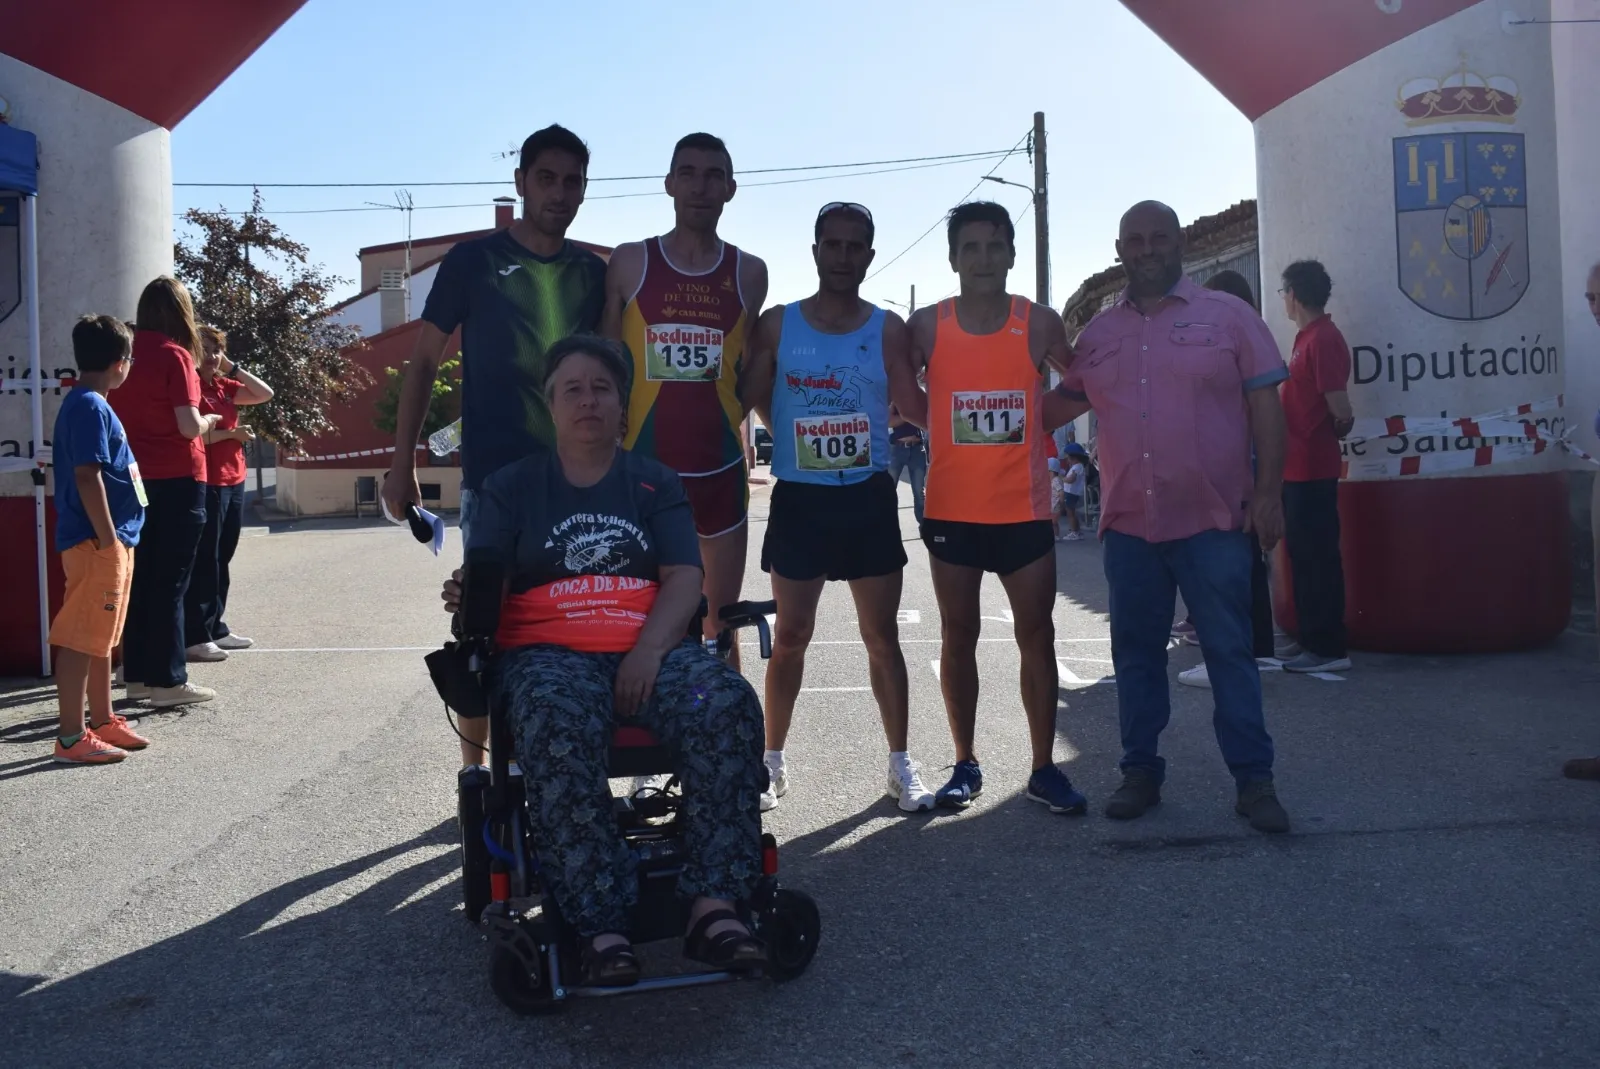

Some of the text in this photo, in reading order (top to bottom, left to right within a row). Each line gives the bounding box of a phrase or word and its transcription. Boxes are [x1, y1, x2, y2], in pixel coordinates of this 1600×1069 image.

[677, 283, 711, 294] VINO
[664, 293, 721, 306] DE TORO
[647, 328, 722, 346] bedunia
[661, 345, 708, 368] 135
[1352, 334, 1558, 391] Diputación
[953, 394, 1024, 411] bedunia
[795, 419, 869, 437] bedunia
[968, 410, 1010, 432] 111
[812, 436, 857, 459] 108
[553, 513, 595, 536] Carrera
[593, 576, 614, 593] DE
[557, 600, 585, 609] Official
